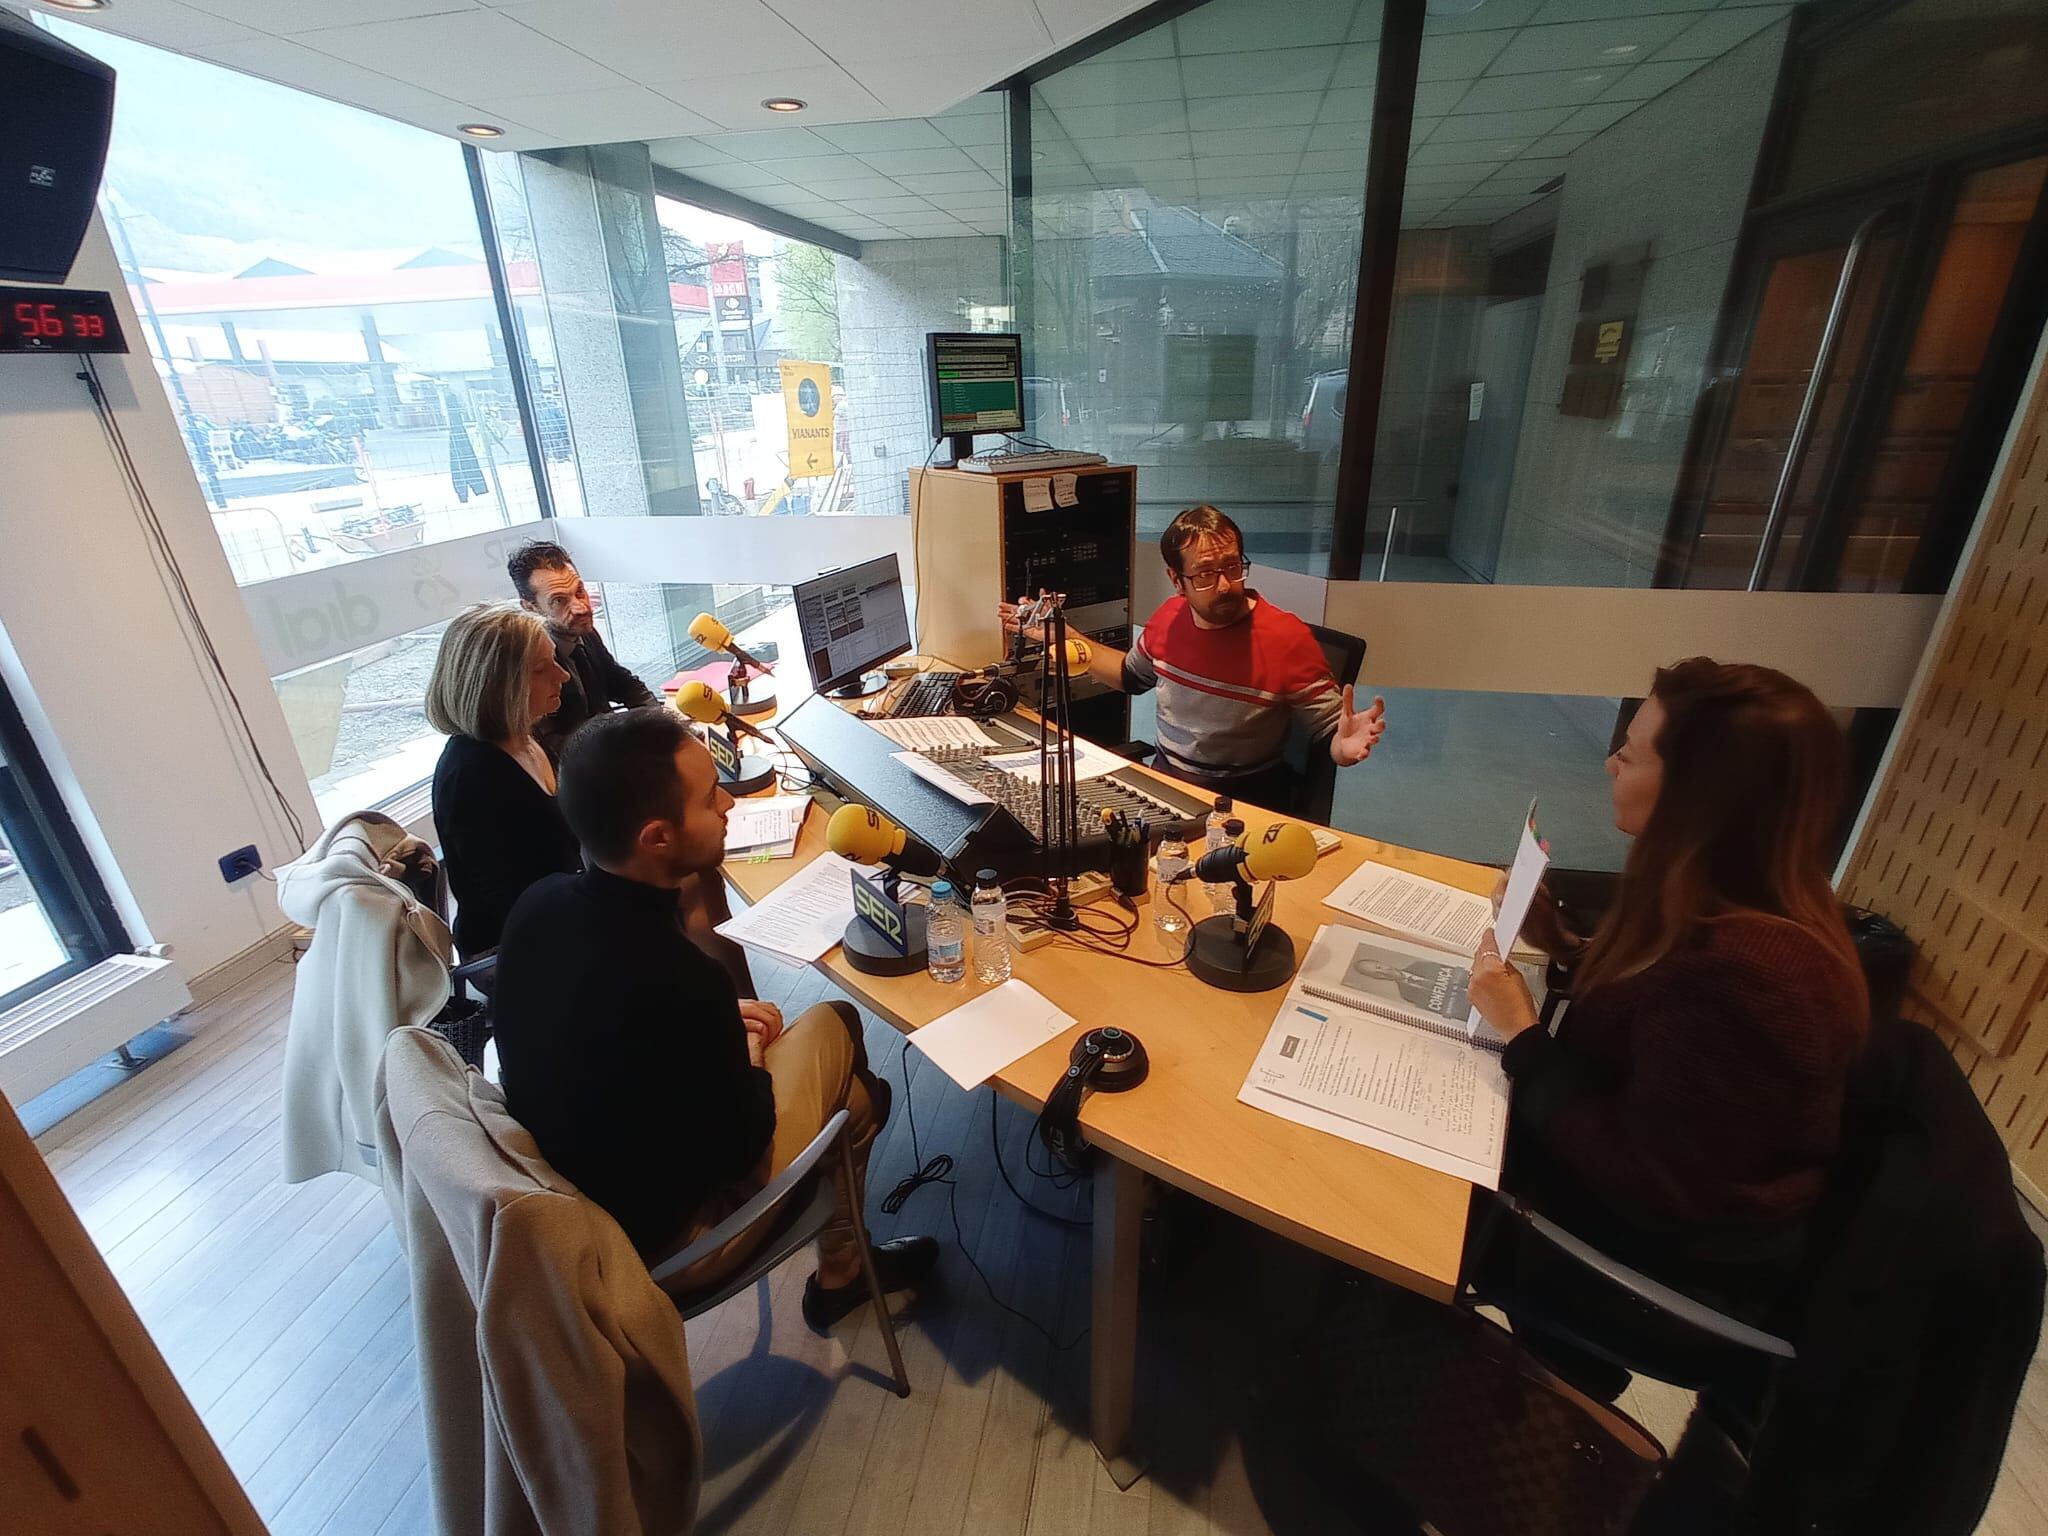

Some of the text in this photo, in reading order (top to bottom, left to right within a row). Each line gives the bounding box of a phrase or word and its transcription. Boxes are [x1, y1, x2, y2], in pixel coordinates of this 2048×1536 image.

[16, 303, 64, 337] 56
[72, 314, 105, 337] 33
[792, 427, 831, 440] VIANANTS
[710, 738, 737, 774] SER
[855, 882, 904, 946] SER
